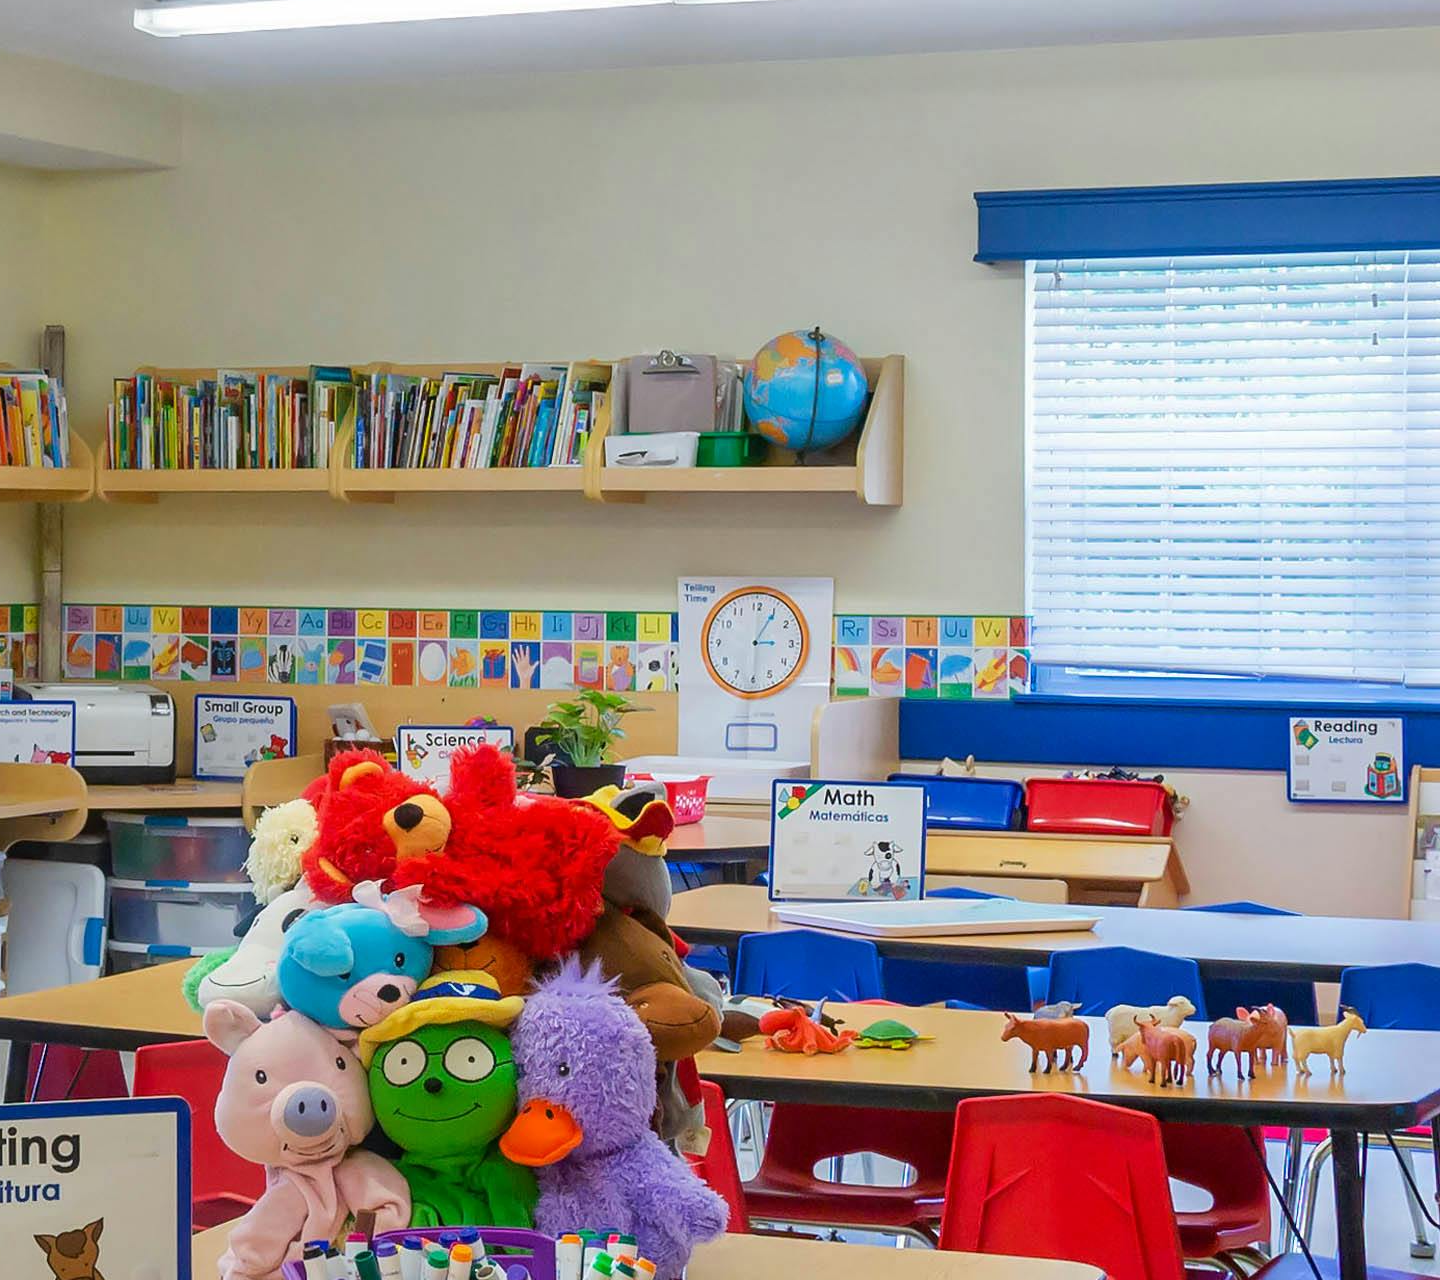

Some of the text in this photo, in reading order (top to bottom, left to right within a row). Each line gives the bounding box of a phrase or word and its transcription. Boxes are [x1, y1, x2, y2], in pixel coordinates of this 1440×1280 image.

[684, 584, 716, 593] Telling
[684, 594, 708, 603] Time
[752, 602, 763, 611] 12
[733, 607, 743, 617] 11
[127, 610, 148, 626] Uu
[245, 613, 263, 634] Yy
[300, 613, 324, 629] Aa
[361, 613, 382, 630] Cc
[514, 618, 537, 633] Hh
[579, 618, 599, 639] Jj
[721, 620, 732, 629] 10
[783, 620, 790, 629] 2
[842, 620, 1001, 639] Rr Ss Tt Uu Vv
[715, 639, 722, 648] 9
[788, 640, 794, 649] 3
[722, 657, 728, 666] 8
[781, 658, 787, 666] 4
[734, 670, 740, 679] 7
[766, 670, 773, 679] 5
[751, 675, 756, 684] 6
[204, 700, 284, 716] Small Group
[11, 709, 26, 717] and
[28, 709, 71, 718] Technology
[1314, 720, 1378, 736] Reading
[426, 732, 487, 747] Science
[1329, 736, 1363, 744] Lectura
[824, 789, 874, 806] Math
[809, 810, 889, 822] Matemáticas
